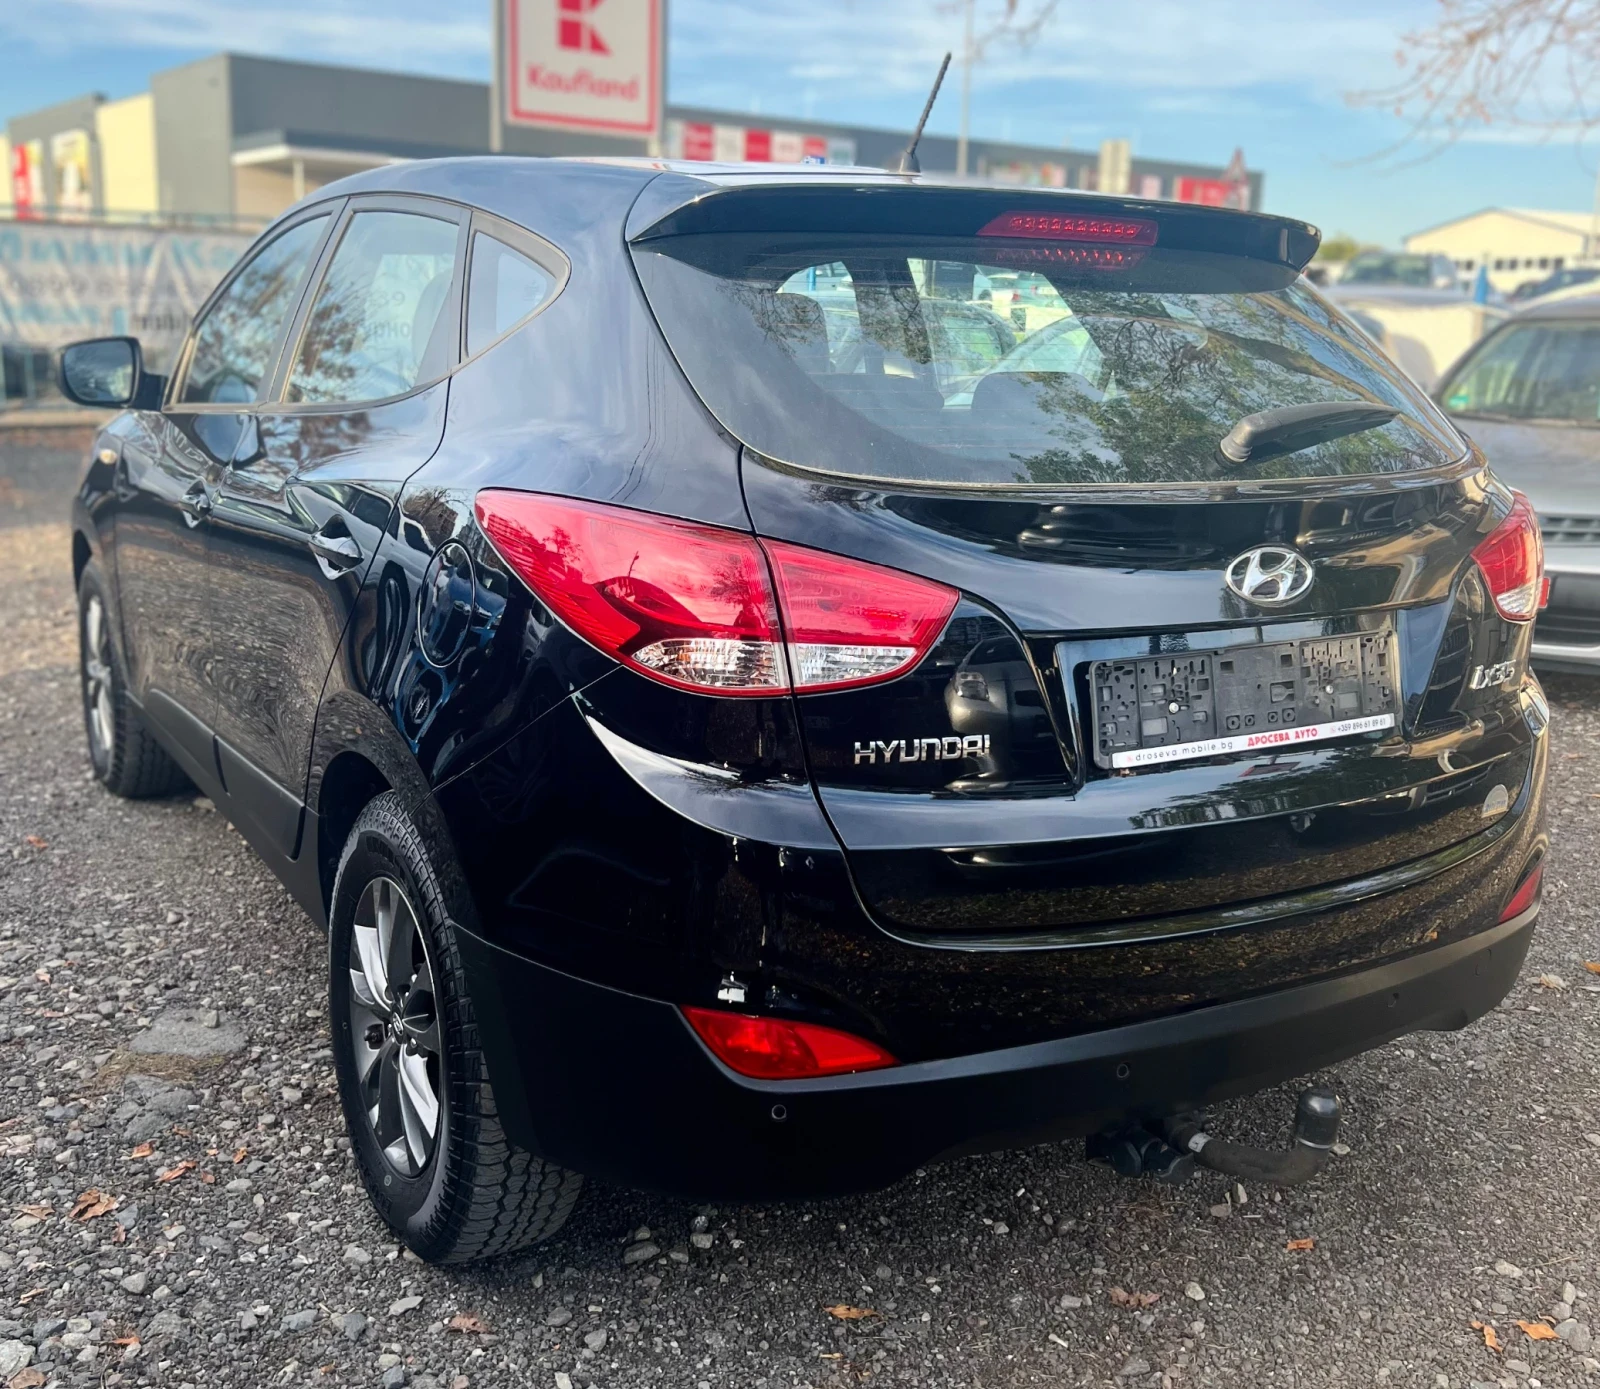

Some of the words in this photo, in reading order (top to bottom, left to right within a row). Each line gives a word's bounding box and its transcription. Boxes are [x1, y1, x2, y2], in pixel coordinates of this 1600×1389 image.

[527, 63, 640, 101] Kaufland
[1470, 660, 1517, 690] ix35
[854, 734, 991, 765] HYUNDAI
[1247, 732, 1290, 748] ДРОСЕВА
[1294, 728, 1318, 740] АУТО
